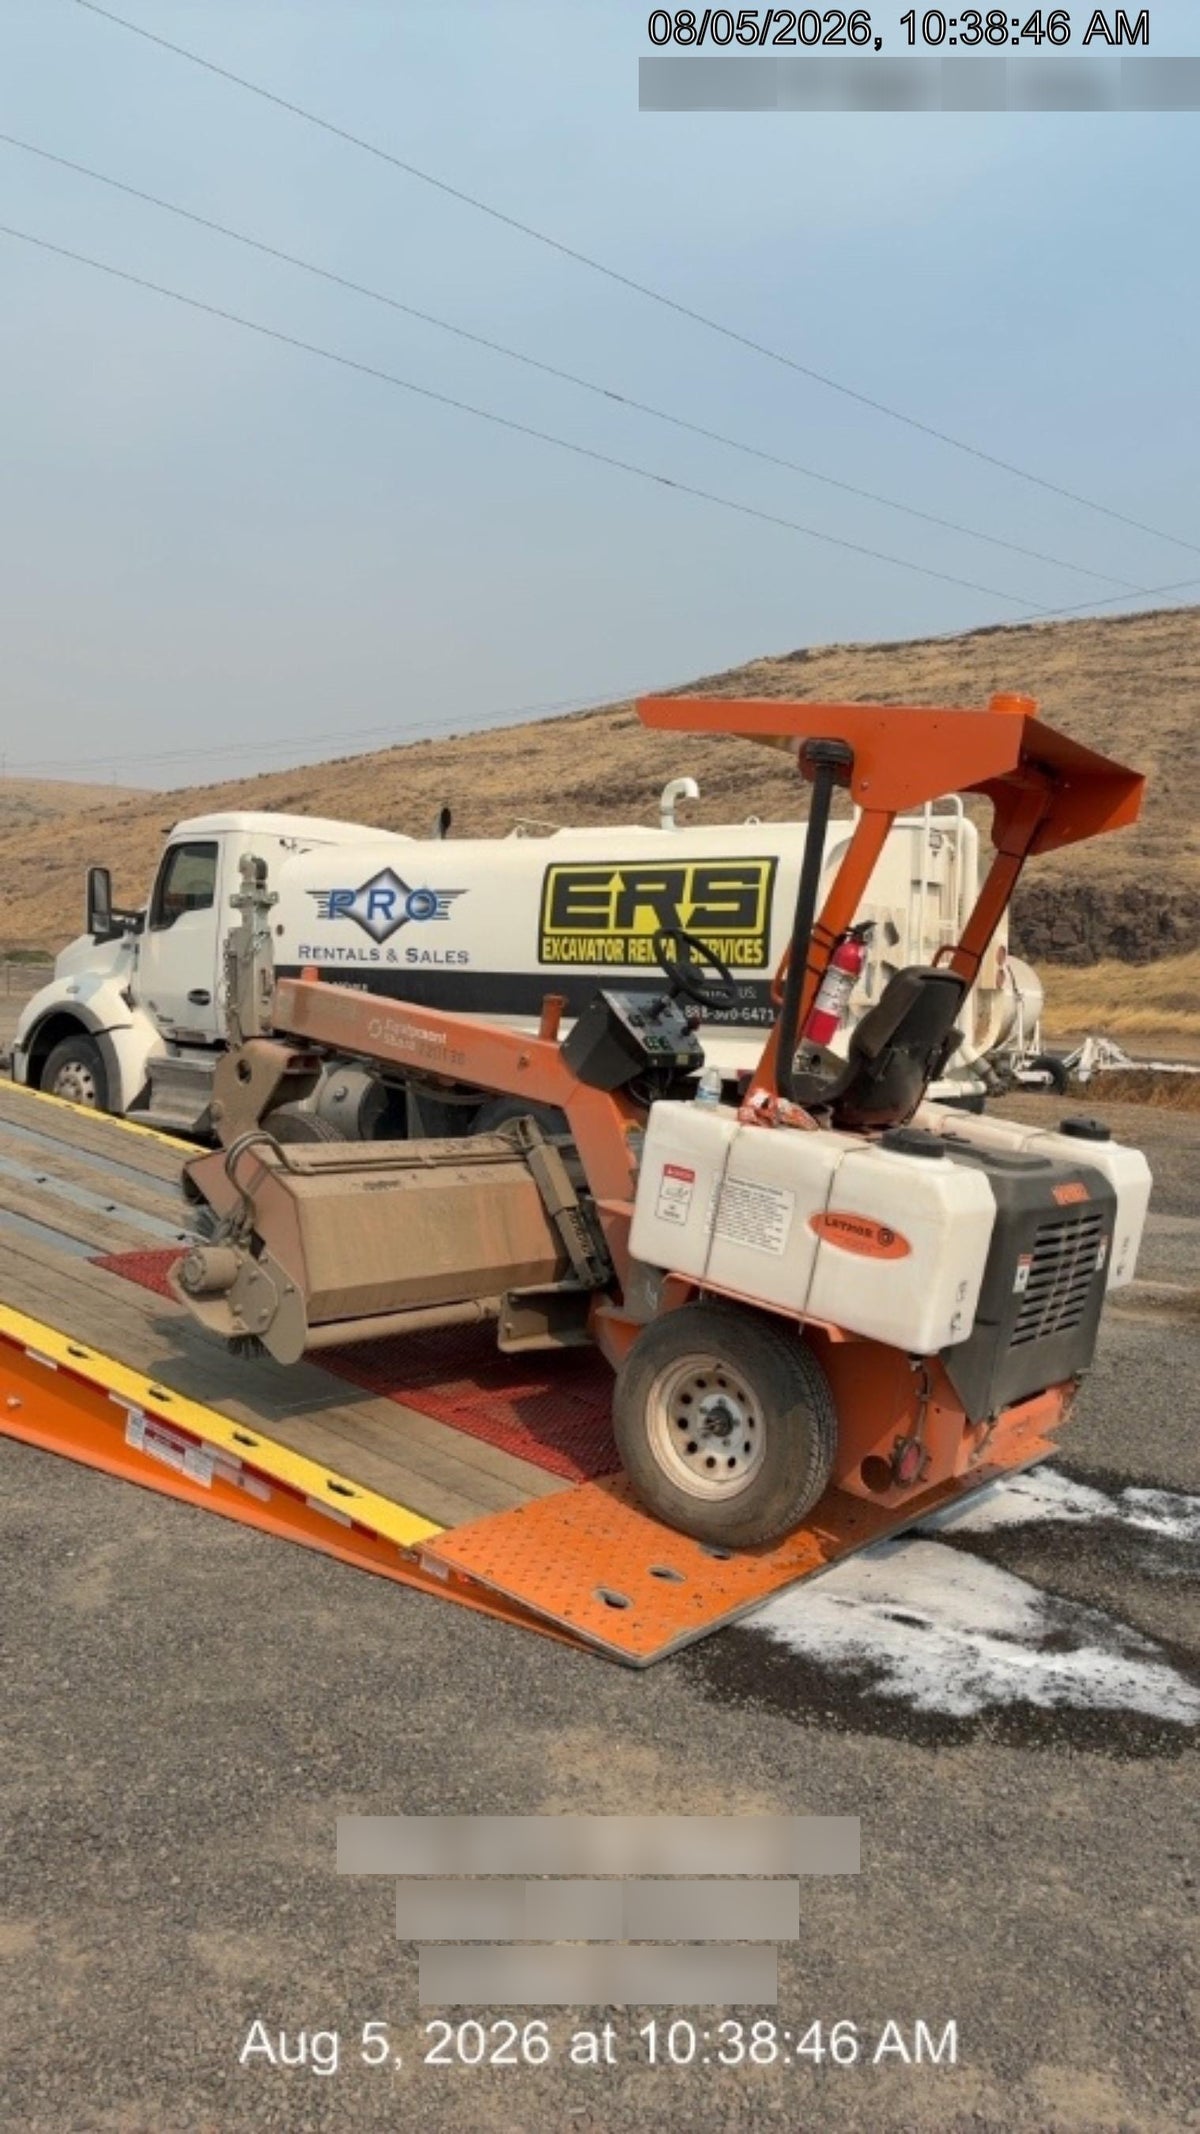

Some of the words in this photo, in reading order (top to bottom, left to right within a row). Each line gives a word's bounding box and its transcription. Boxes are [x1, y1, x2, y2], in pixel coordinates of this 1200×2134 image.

[328, 889, 437, 921] PRO
[549, 868, 762, 929] ERS
[298, 945, 380, 961] RENTALS
[386, 949, 398, 963] &
[405, 948, 470, 964] SALES
[542, 937, 625, 963] EXCAVATOR
